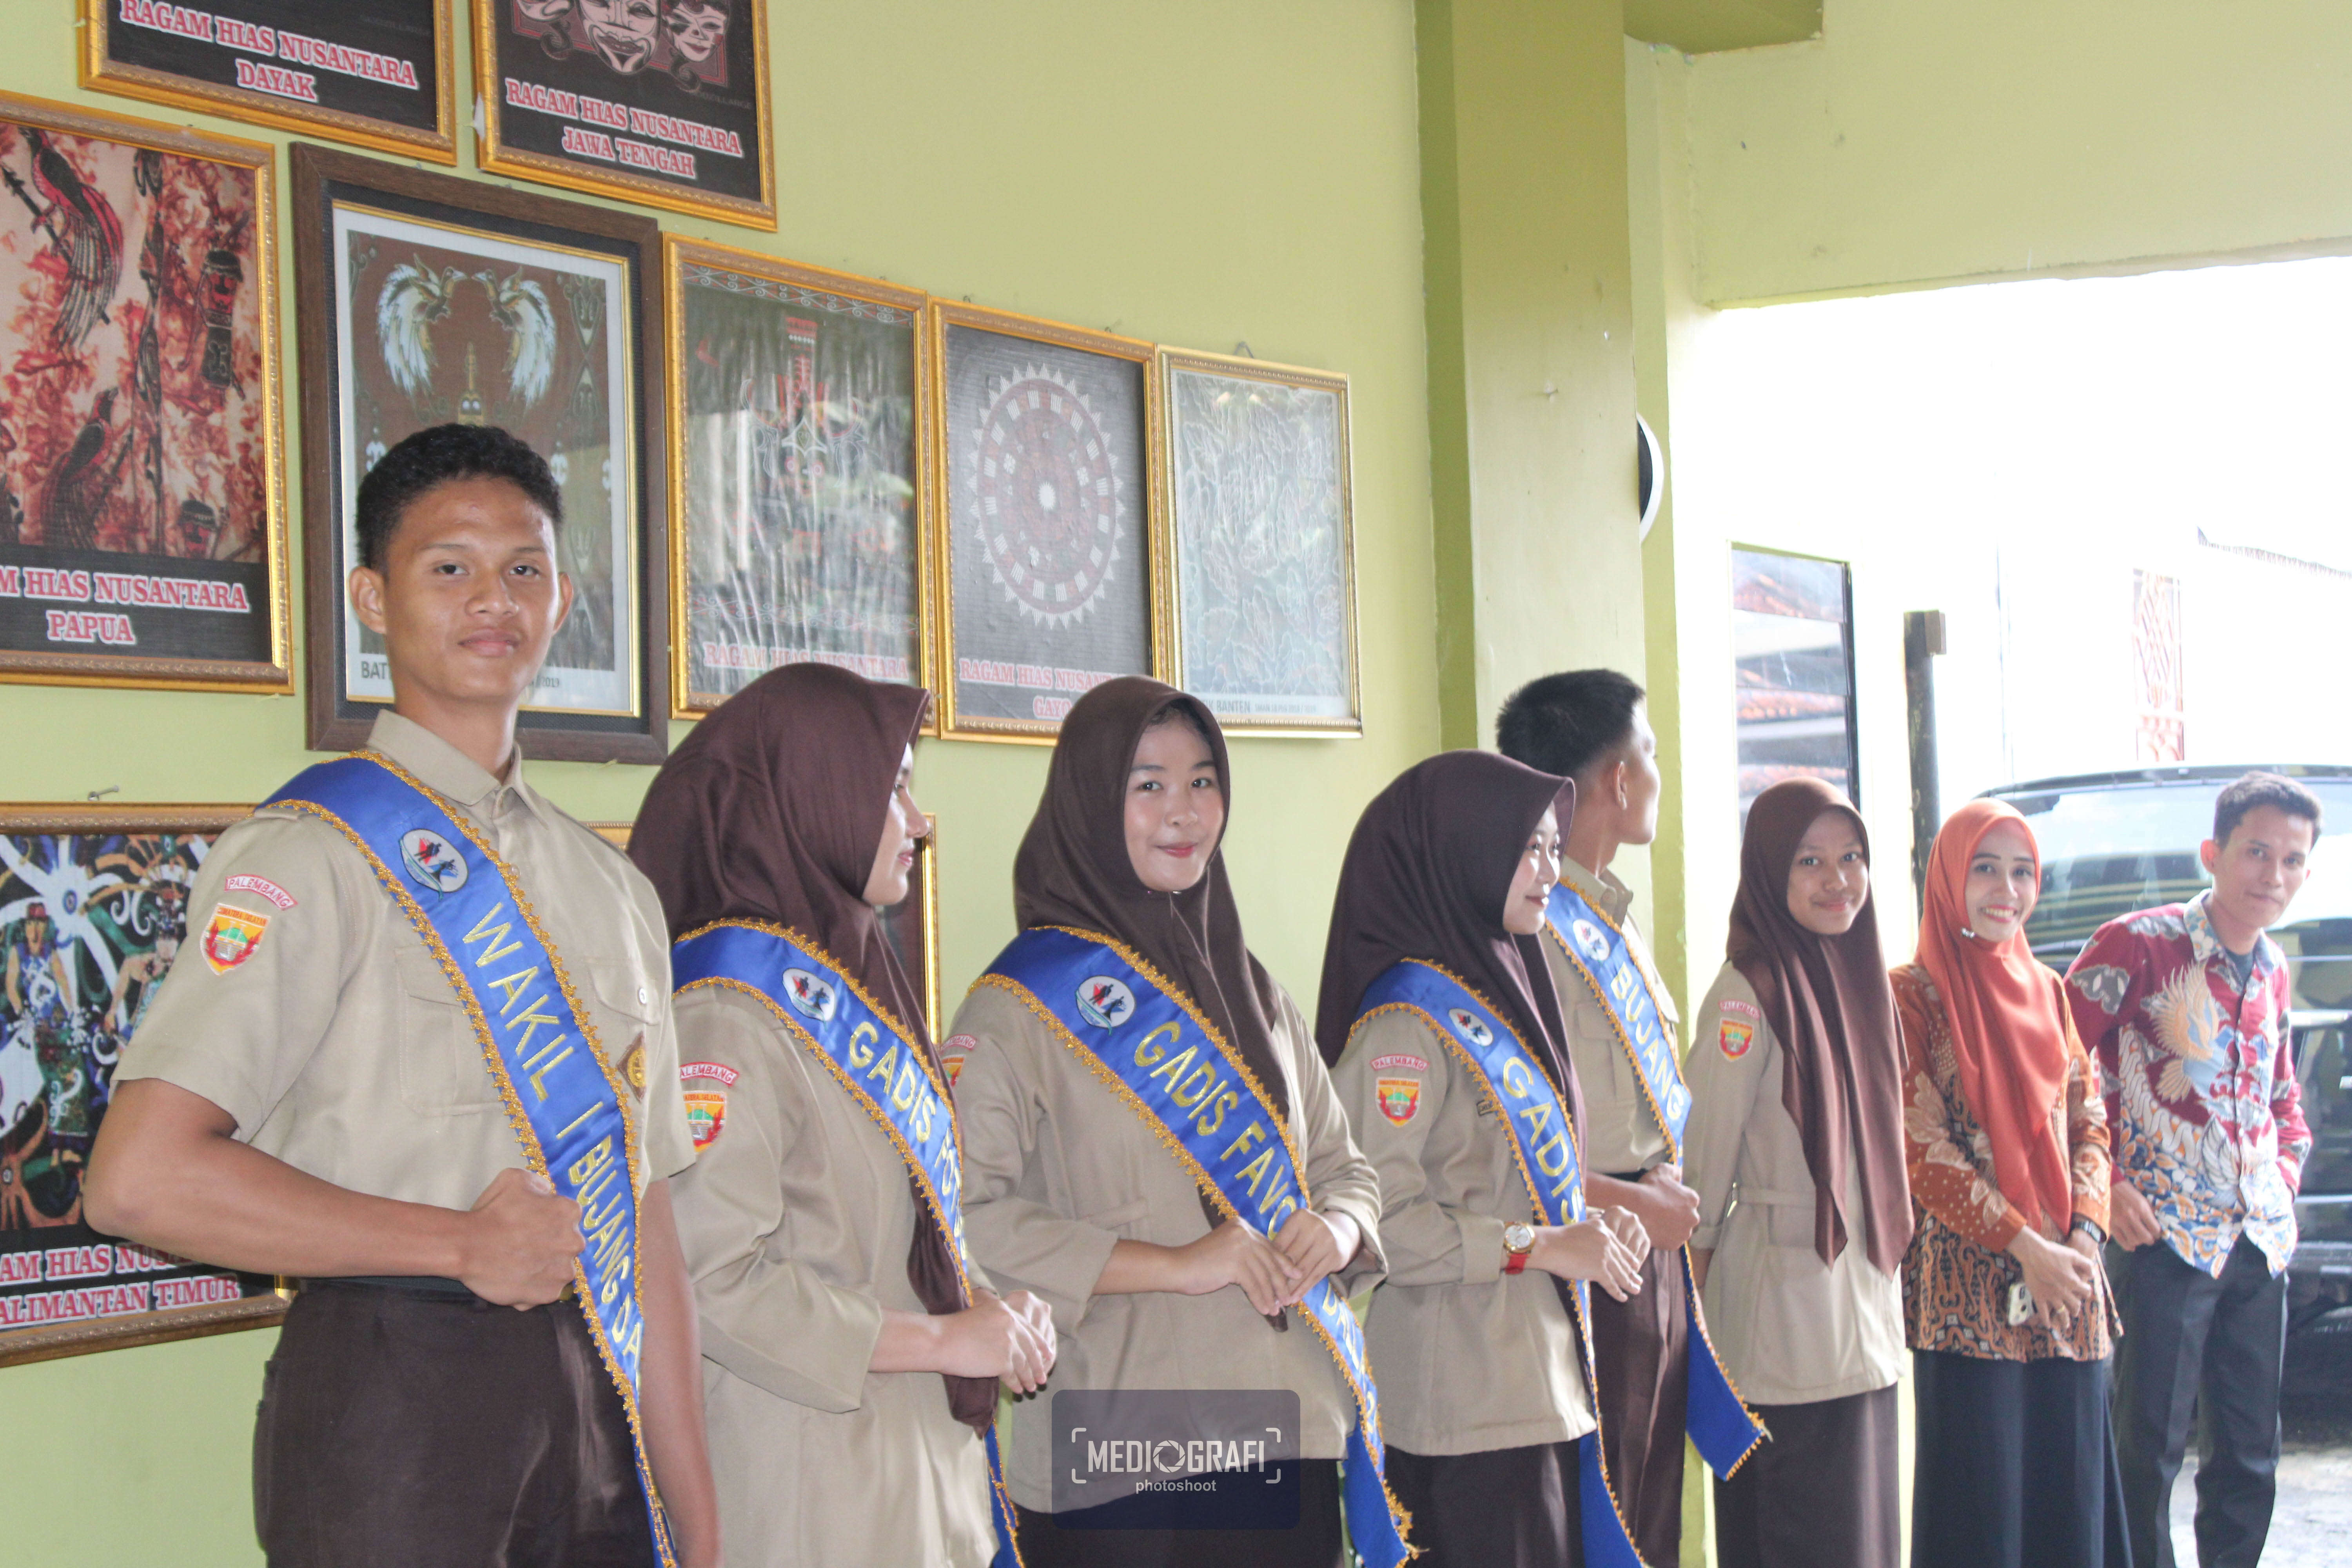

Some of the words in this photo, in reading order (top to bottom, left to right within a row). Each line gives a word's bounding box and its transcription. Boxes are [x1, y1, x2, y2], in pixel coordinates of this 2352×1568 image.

[120, 0, 214, 43] RAGAM
[214, 15, 276, 56] HIAS
[278, 30, 420, 90] NUSANTARA
[235, 58, 318, 102] DAYAK
[505, 78, 578, 120] RAGAM
[579, 96, 628, 130] HIAS
[629, 107, 744, 158] NUSANTARA
[561, 126, 616, 162] JAWA
[614, 137, 696, 180] TENGAH
[23, 567, 90, 601] HIAS
[93, 572, 251, 613] NUSANTARA
[45, 610, 136, 644] PAPUA
[361, 661, 388, 679] BAT
[702, 642, 768, 670] RAGAM
[959, 658, 1015, 686] RAGAM
[1016, 664, 1053, 689] HIAS
[1033, 695, 1073, 720] GAYO
[1216, 700, 1250, 713] BANTEN
[228, 877, 290, 907] PALEMBANG
[1610, 961, 1684, 1120] BUJANG
[680, 1065, 733, 1082] ALEMBANG
[849, 1021, 936, 1143] GADIS
[463, 902, 574, 1102] WAKIL
[568, 1135, 632, 1305] BUJANG
[1134, 1021, 1238, 1136] GADIS
[1220, 1120, 1296, 1241] FAVO
[1503, 1056, 1584, 1225] GADIS
[44, 1244, 112, 1281] HIAS
[0, 1282, 150, 1329] ALIMANTAN
[152, 1273, 240, 1310] TIMUR
